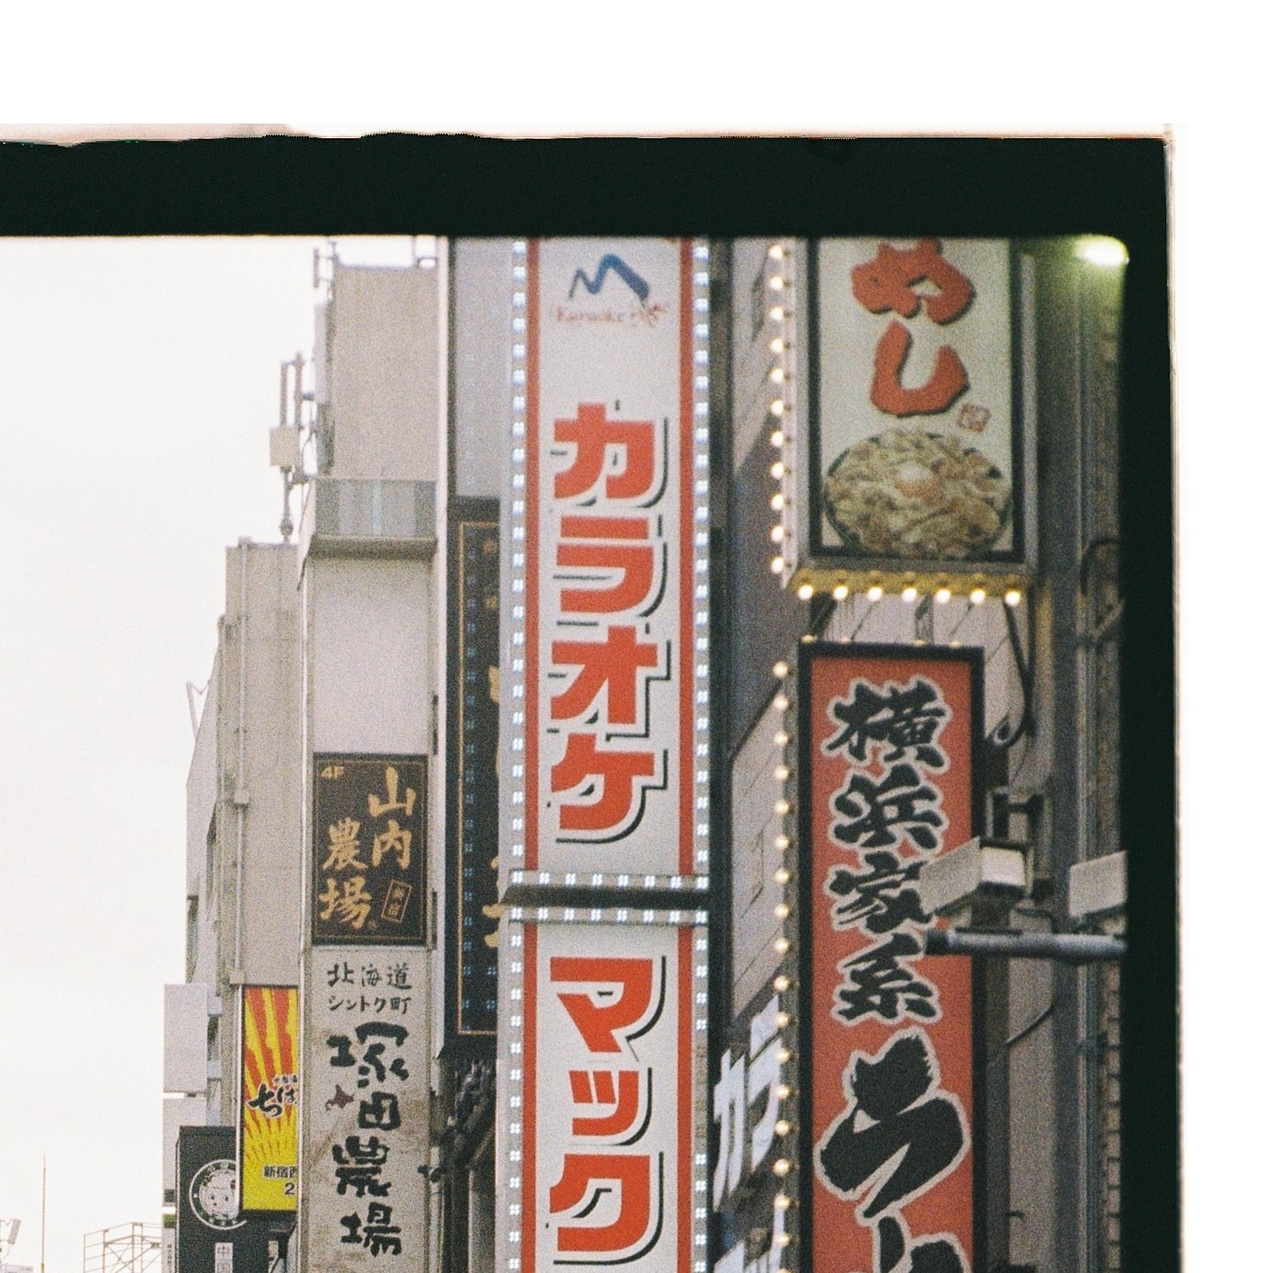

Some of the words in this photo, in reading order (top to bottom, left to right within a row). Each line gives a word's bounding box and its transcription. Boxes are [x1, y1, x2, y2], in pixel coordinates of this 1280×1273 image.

[549, 400, 670, 844] カラオケ
[321, 765, 345, 780] 4F
[367, 765, 417, 870] 山内
[318, 816, 372, 930] 農場
[326, 962, 413, 991] 北海道
[327, 995, 413, 1015] シントク町
[324, 1022, 411, 1258] 塚田農場
[548, 954, 666, 1265] マック
